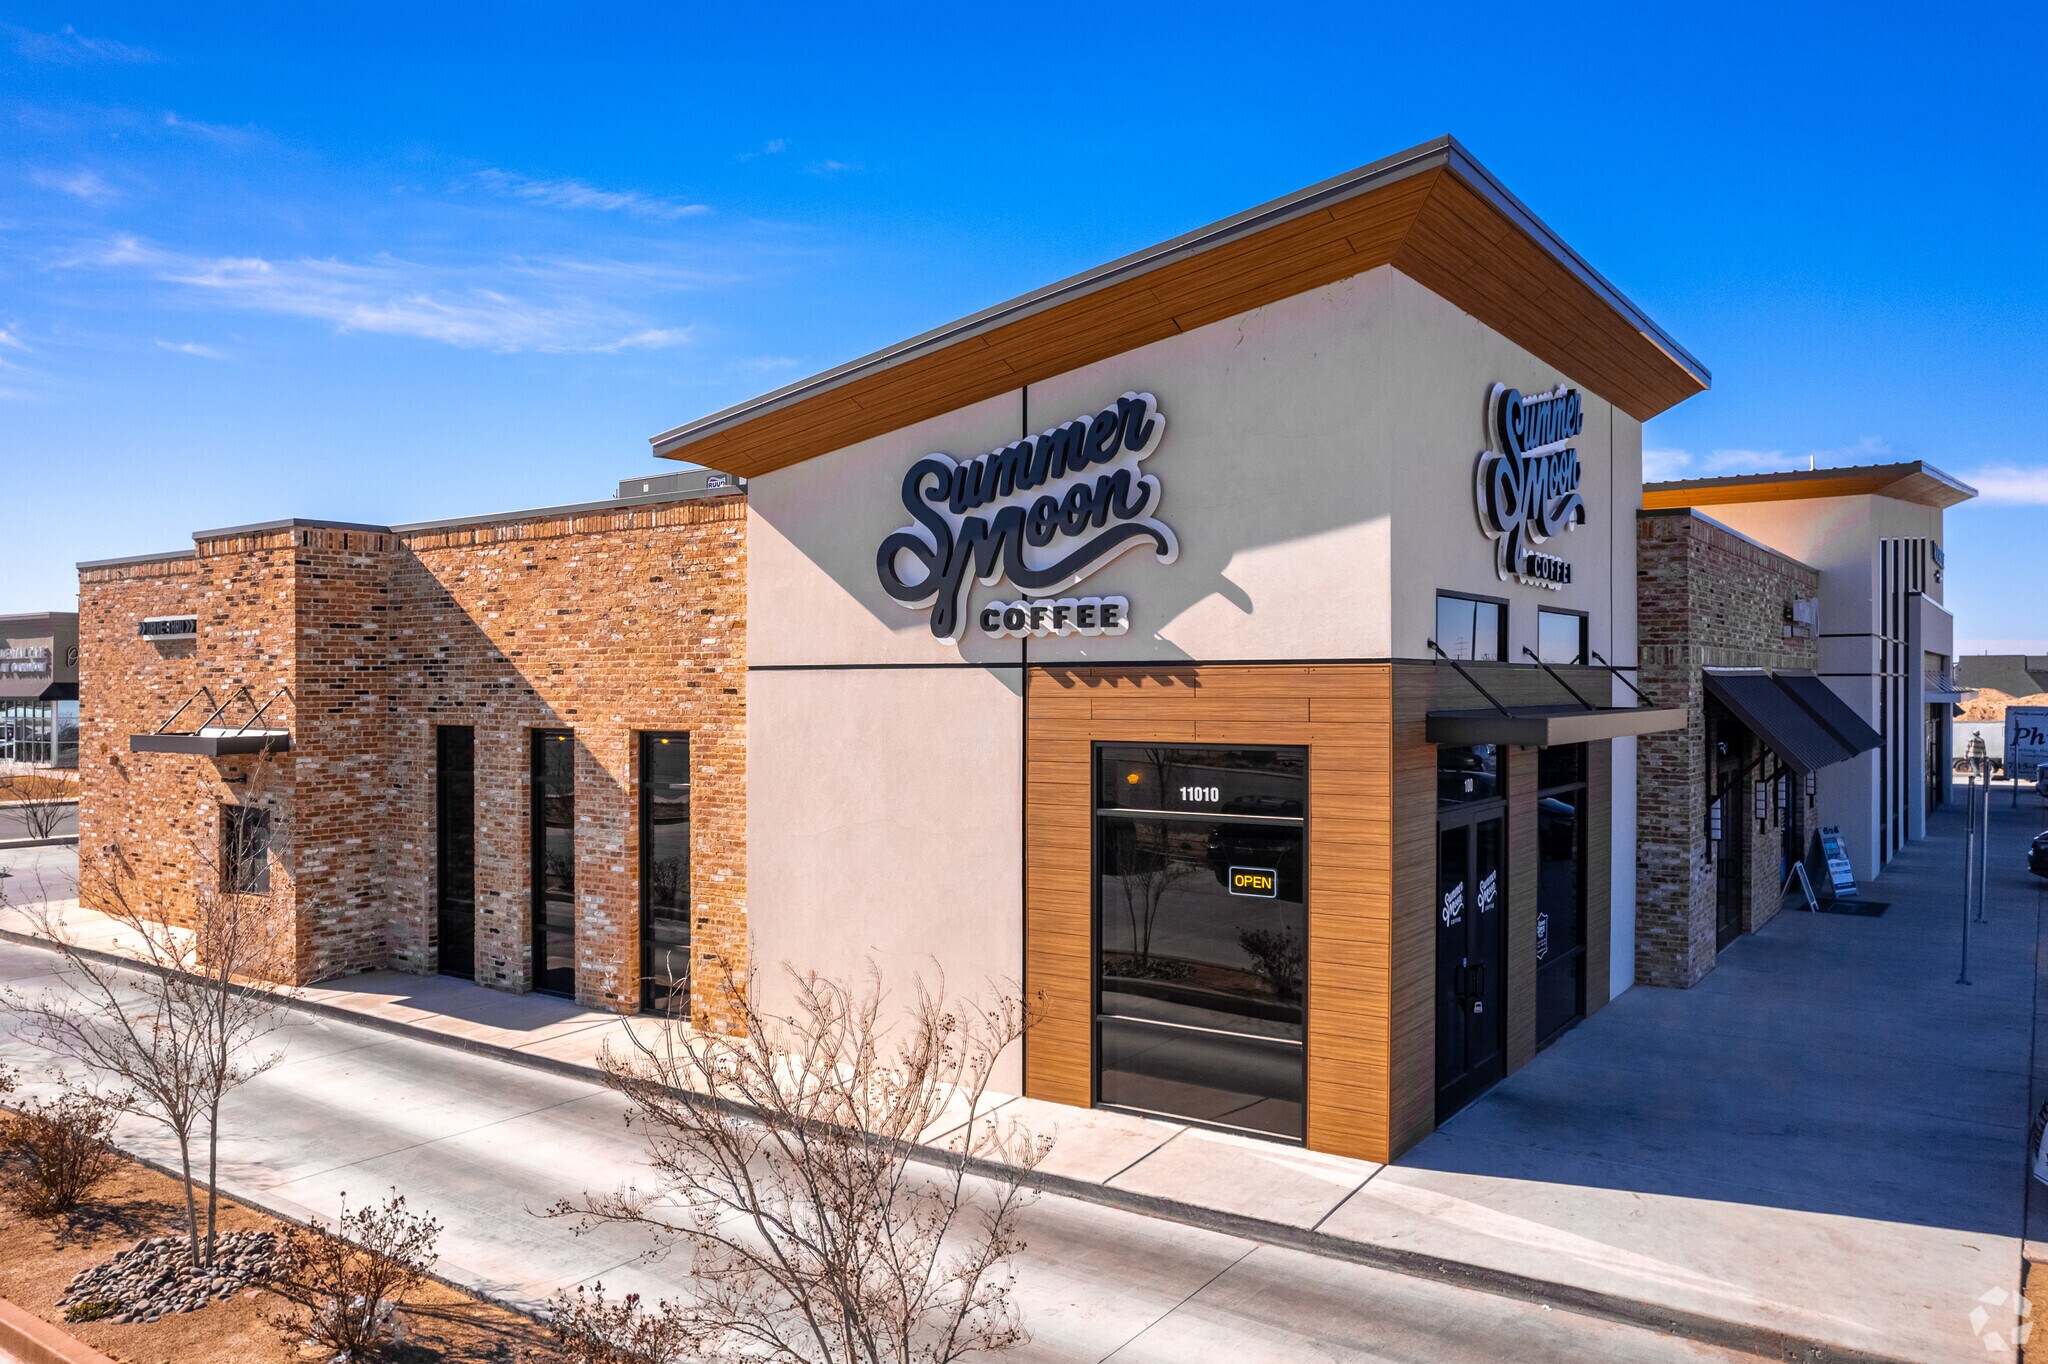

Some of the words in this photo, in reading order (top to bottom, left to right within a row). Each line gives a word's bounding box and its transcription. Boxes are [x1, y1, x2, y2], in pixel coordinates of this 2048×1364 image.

[877, 397, 1156, 602] Summer
[931, 467, 1169, 638] Moon
[1528, 554, 1571, 584] COFFE
[979, 603, 1120, 633] COFFEE
[2010, 726, 2048, 747] Ph
[1179, 786, 1220, 802] 11010
[1234, 874, 1272, 890] OPEN
